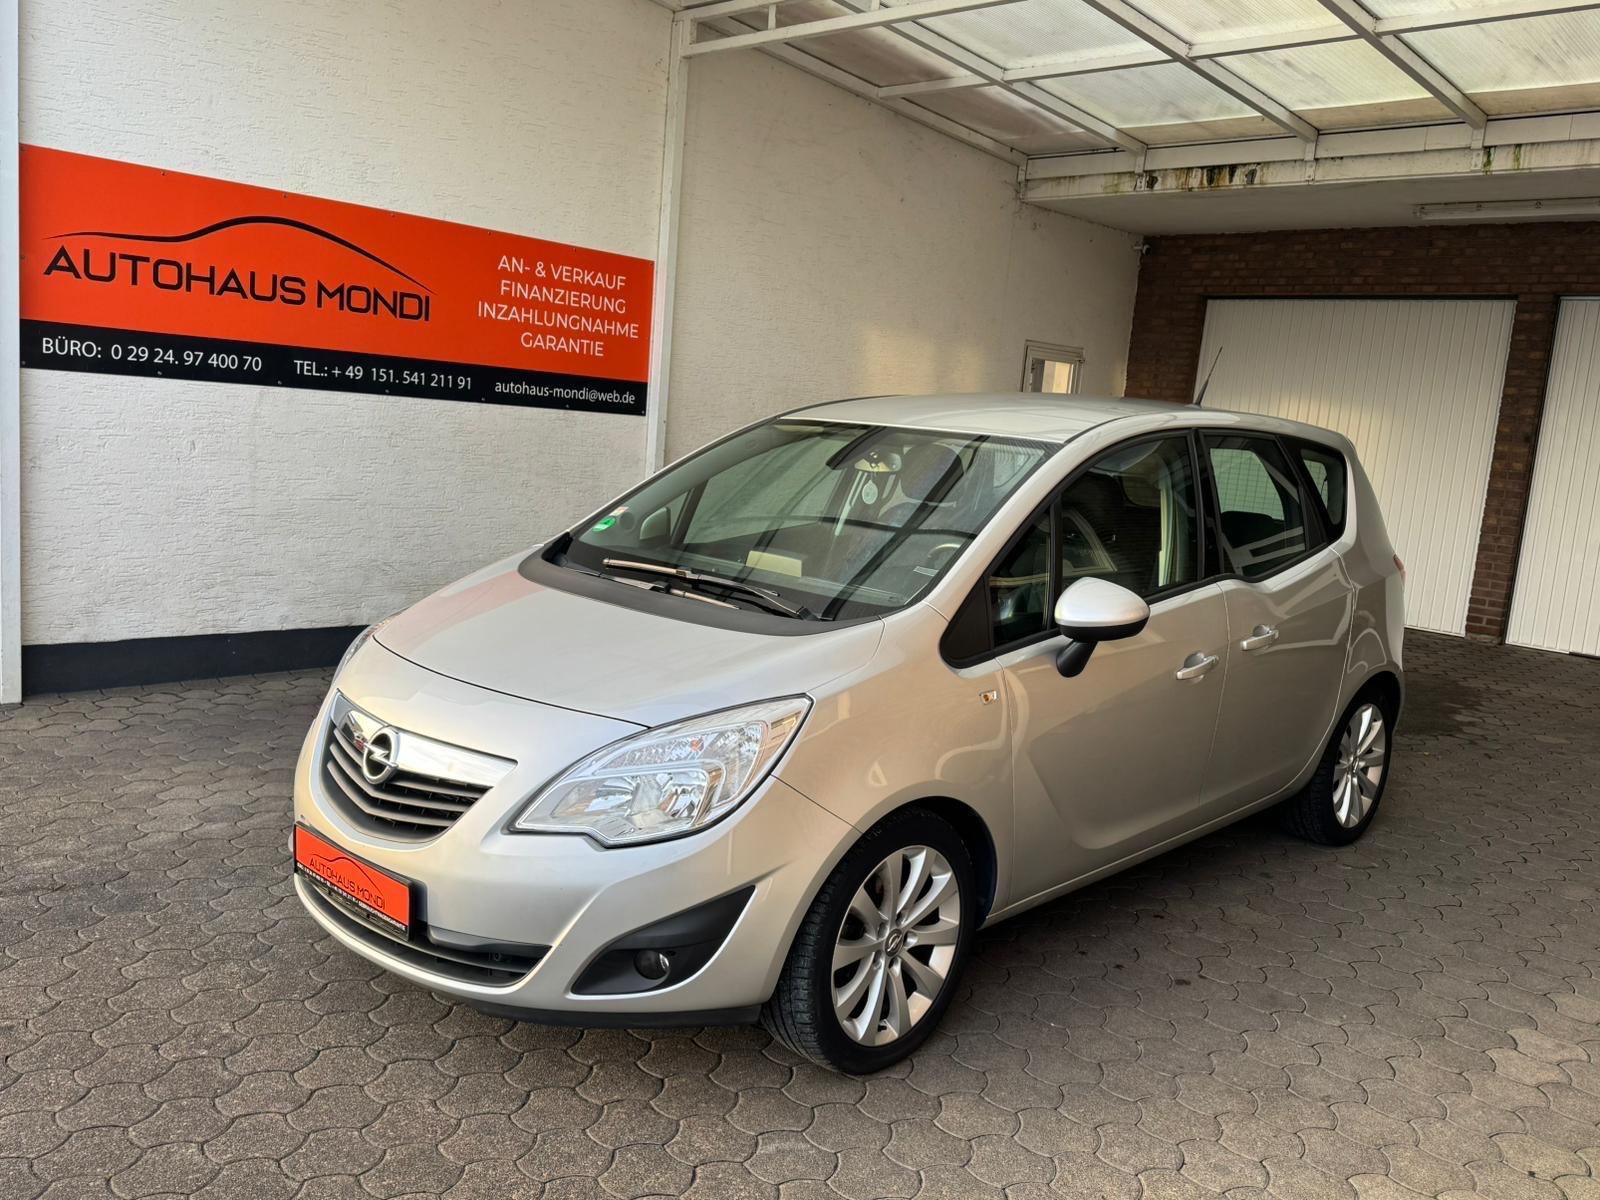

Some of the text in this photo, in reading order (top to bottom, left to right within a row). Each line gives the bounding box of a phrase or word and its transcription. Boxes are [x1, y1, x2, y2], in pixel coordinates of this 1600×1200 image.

[43, 244, 431, 322] AUTOHAUS MONDI
[497, 255, 626, 290] AN- & VERKAUF
[500, 279, 626, 314] FINANZIERUNG
[478, 301, 639, 339] INZAHLUNGNAHME
[42, 335, 262, 371] BÜRO: 0 29 24. 97 400 70
[520, 331, 604, 357] GARANTIE
[293, 360, 328, 377] TEL.:
[345, 365, 364, 380] 49
[494, 380, 636, 404] autohaus-mondi@web.de
[309, 857, 356, 893] AUTOHAUS
[356, 884, 386, 911] MONDI
